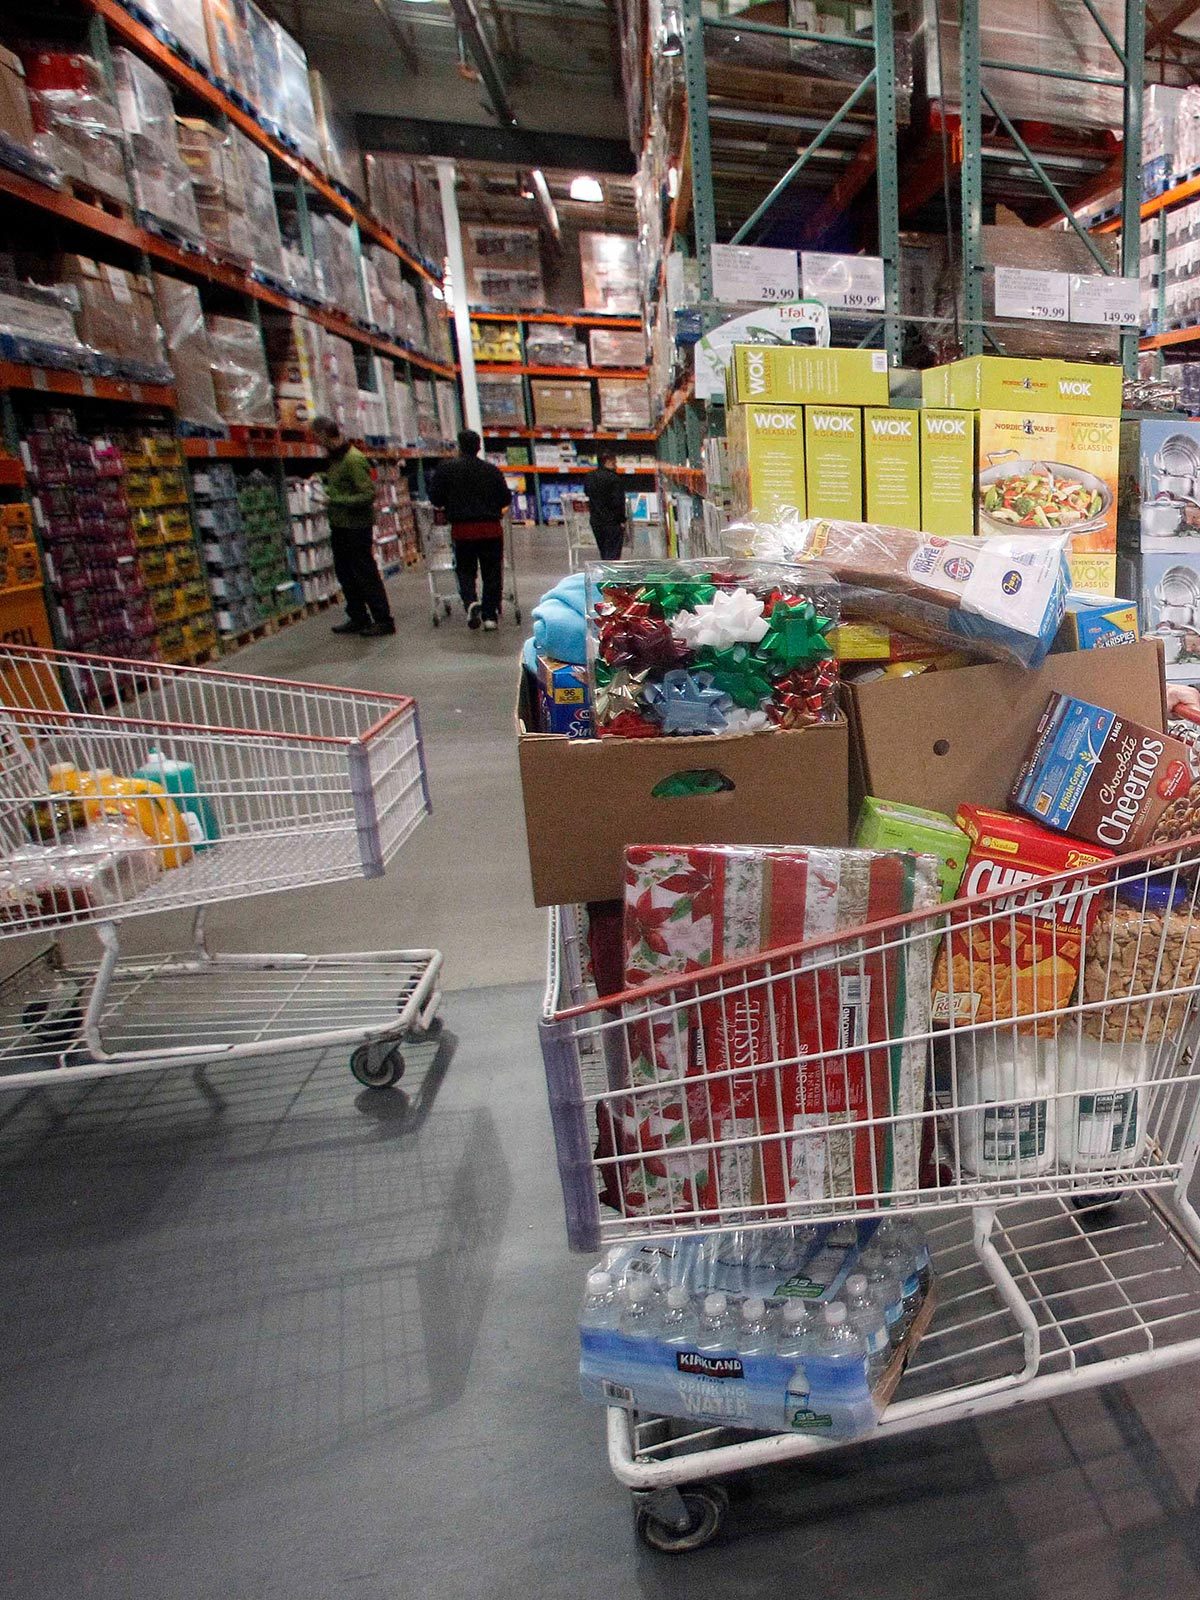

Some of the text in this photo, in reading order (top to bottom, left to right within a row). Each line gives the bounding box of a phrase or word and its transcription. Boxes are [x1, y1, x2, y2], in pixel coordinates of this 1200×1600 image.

[762, 287, 795, 300] 29.99
[843, 294, 880, 305] 189.99
[1103, 312, 1136, 322] 149.99
[748, 351, 766, 395] WOK
[1058, 382, 1092, 396] WOK
[754, 414, 797, 429] WOK
[812, 416, 854, 432] WOK
[872, 420, 912, 435] WOK
[926, 420, 966, 435] WOK
[994, 423, 1024, 431] NORDIC
[1072, 429, 1113, 444] WOK
[918, 548, 940, 574] WHITE
[1104, 631, 1136, 648] KRISPIES
[1112, 722, 1123, 738] BAGS
[1100, 736, 1137, 805] Chocolate
[1058, 764, 1085, 810] Whole Grain
[1066, 772, 1088, 812] Guaranteed
[1097, 737, 1164, 846] Cheerios
[1067, 850, 1080, 868] 2
[1080, 854, 1094, 863] BAGS
[734, 1001, 760, 1089] TSSUE
[679, 1354, 742, 1370] KIRKLAND
[679, 1392, 749, 1415] WATER
